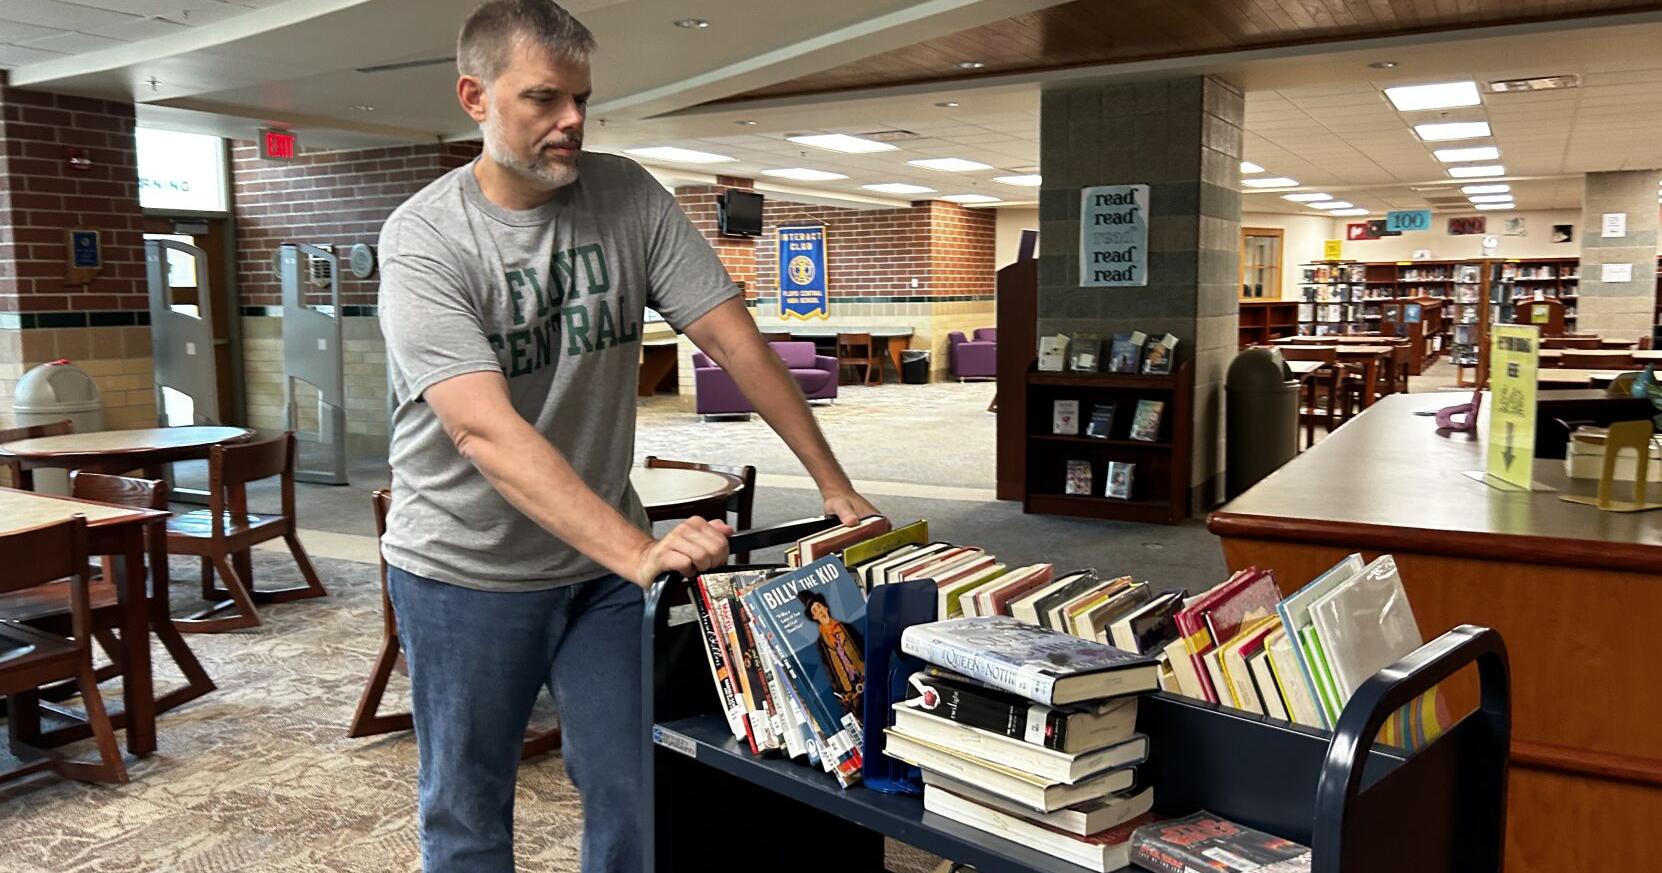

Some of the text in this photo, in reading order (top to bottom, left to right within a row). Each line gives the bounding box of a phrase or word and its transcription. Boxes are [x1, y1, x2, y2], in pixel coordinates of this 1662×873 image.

[266, 132, 295, 159] EXIT
[1095, 188, 1138, 206] read
[1094, 207, 1138, 225] read
[1393, 212, 1424, 228] 100
[789, 242, 813, 251] CLUB
[1093, 245, 1136, 263] read
[1093, 265, 1136, 282] read
[505, 243, 610, 326] FLOYD
[762, 563, 840, 610] BILLY THE KID
[946, 649, 980, 672] QUEEN
[947, 691, 960, 719] twilight
